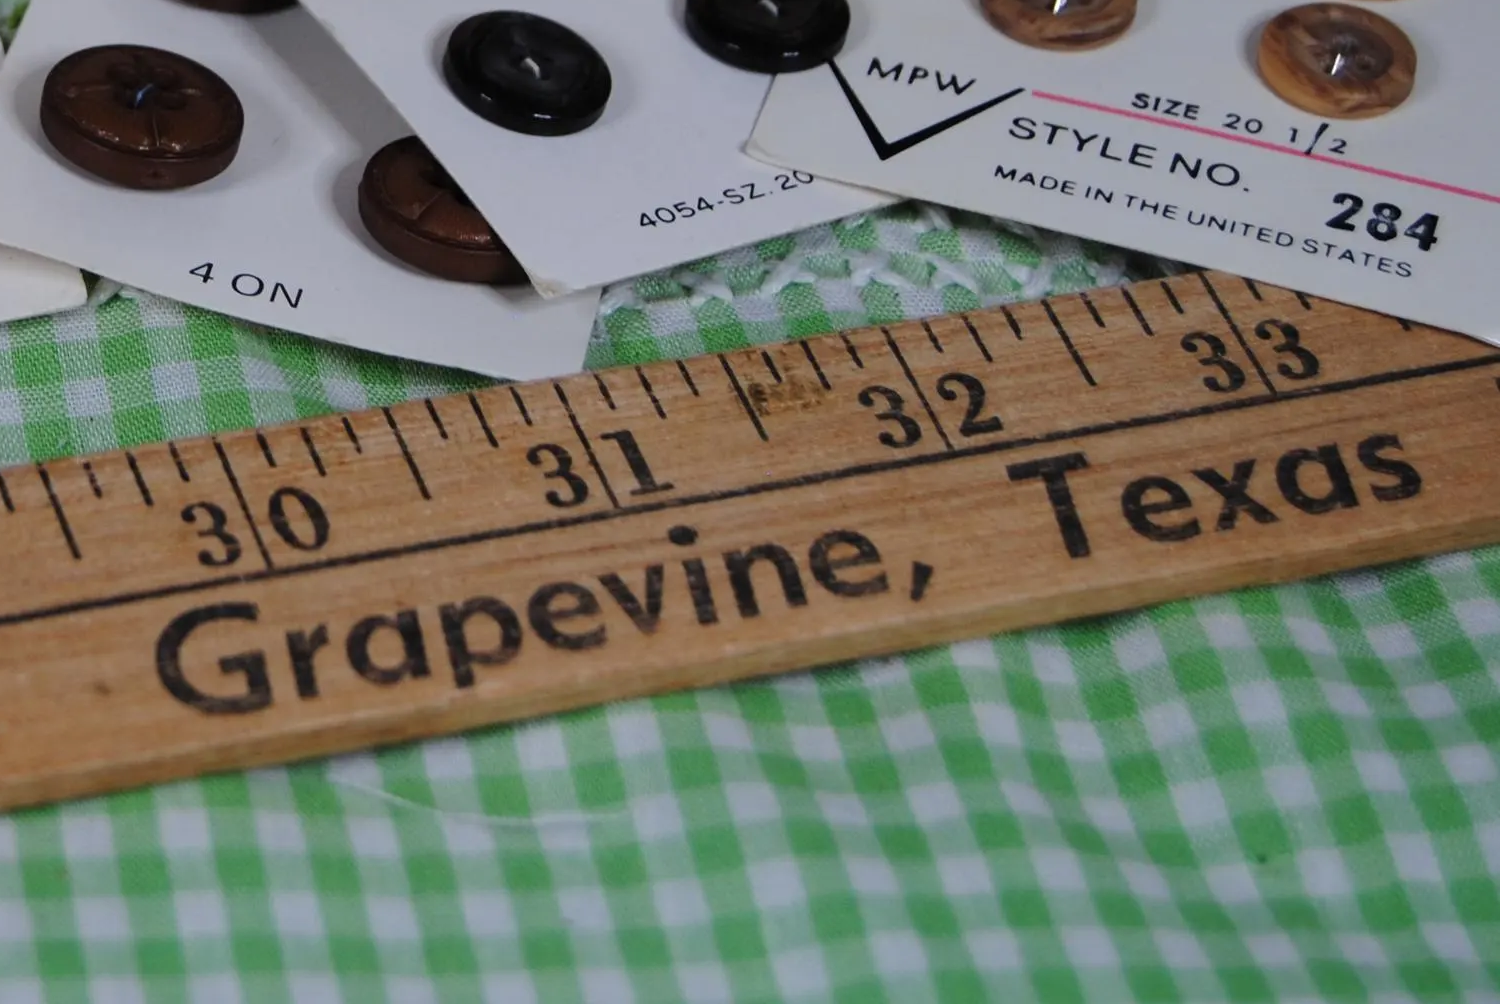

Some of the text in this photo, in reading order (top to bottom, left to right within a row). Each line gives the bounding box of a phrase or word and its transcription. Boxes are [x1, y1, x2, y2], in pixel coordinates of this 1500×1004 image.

[866, 56, 979, 96] MPW
[1008, 115, 1252, 194] STYLE NO.
[1131, 92, 1349, 156] SIZE 20 1/2
[994, 164, 1414, 279] MADE IN THE UNITED STATES
[1323, 191, 1442, 254] 284
[188, 260, 304, 310] 4 ON
[180, 484, 332, 568] 30
[524, 427, 676, 509] 31
[856, 370, 1005, 450] 32
[1179, 316, 1321, 394] 33
[153, 523, 937, 716] Grapevine,
[1004, 432, 1425, 560] Texas
